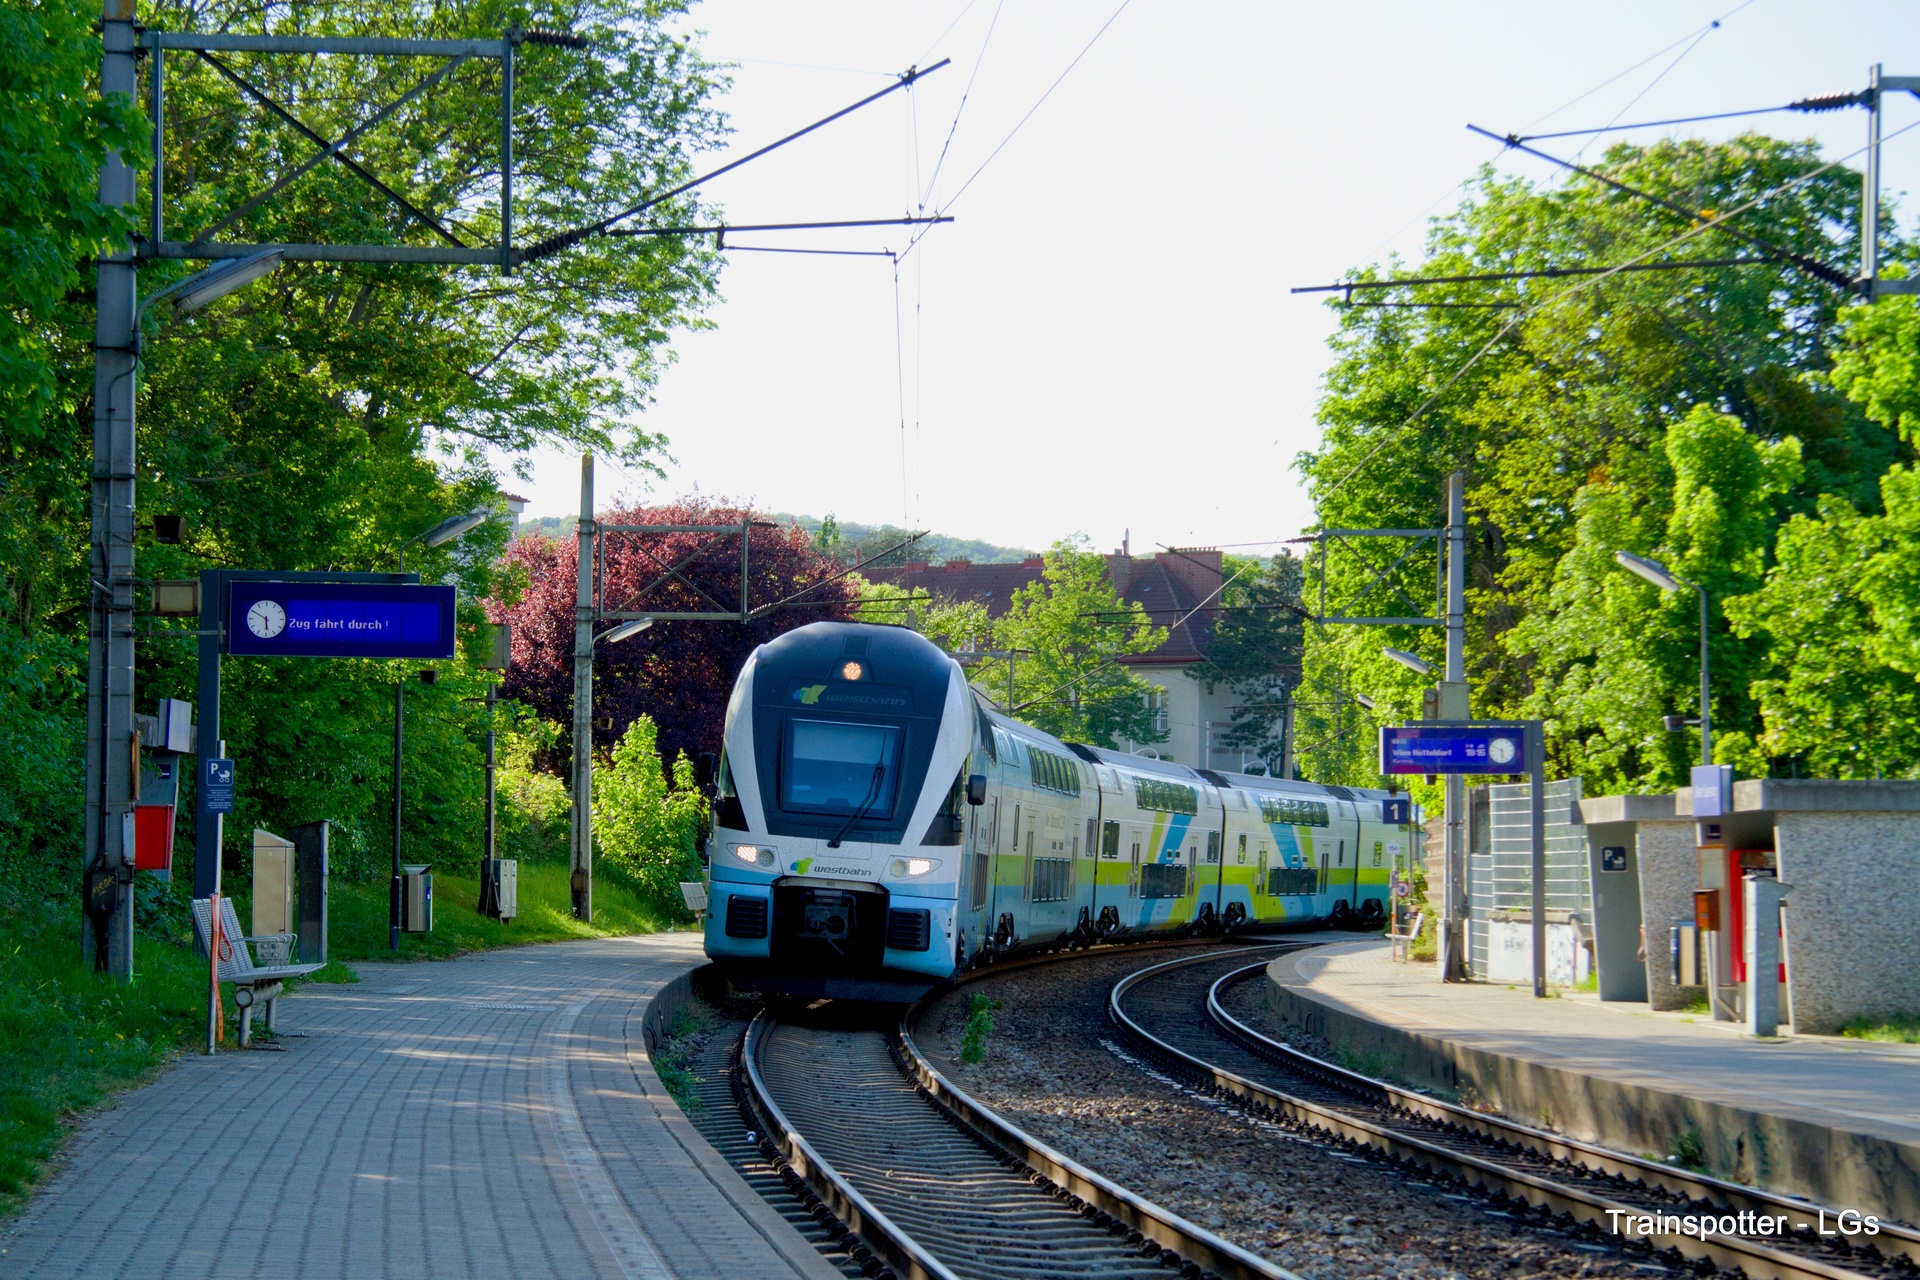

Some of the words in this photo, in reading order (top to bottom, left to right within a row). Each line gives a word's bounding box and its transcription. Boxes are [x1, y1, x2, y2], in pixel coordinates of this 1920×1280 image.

[288, 618, 311, 630] Zug
[314, 618, 345, 629] fährt
[347, 619, 383, 630] durch
[825, 693, 906, 706] westbahn
[210, 762, 219, 775] P
[1390, 803, 1399, 821] 1
[1604, 849, 1613, 861] P
[813, 865, 872, 877] westbahn
